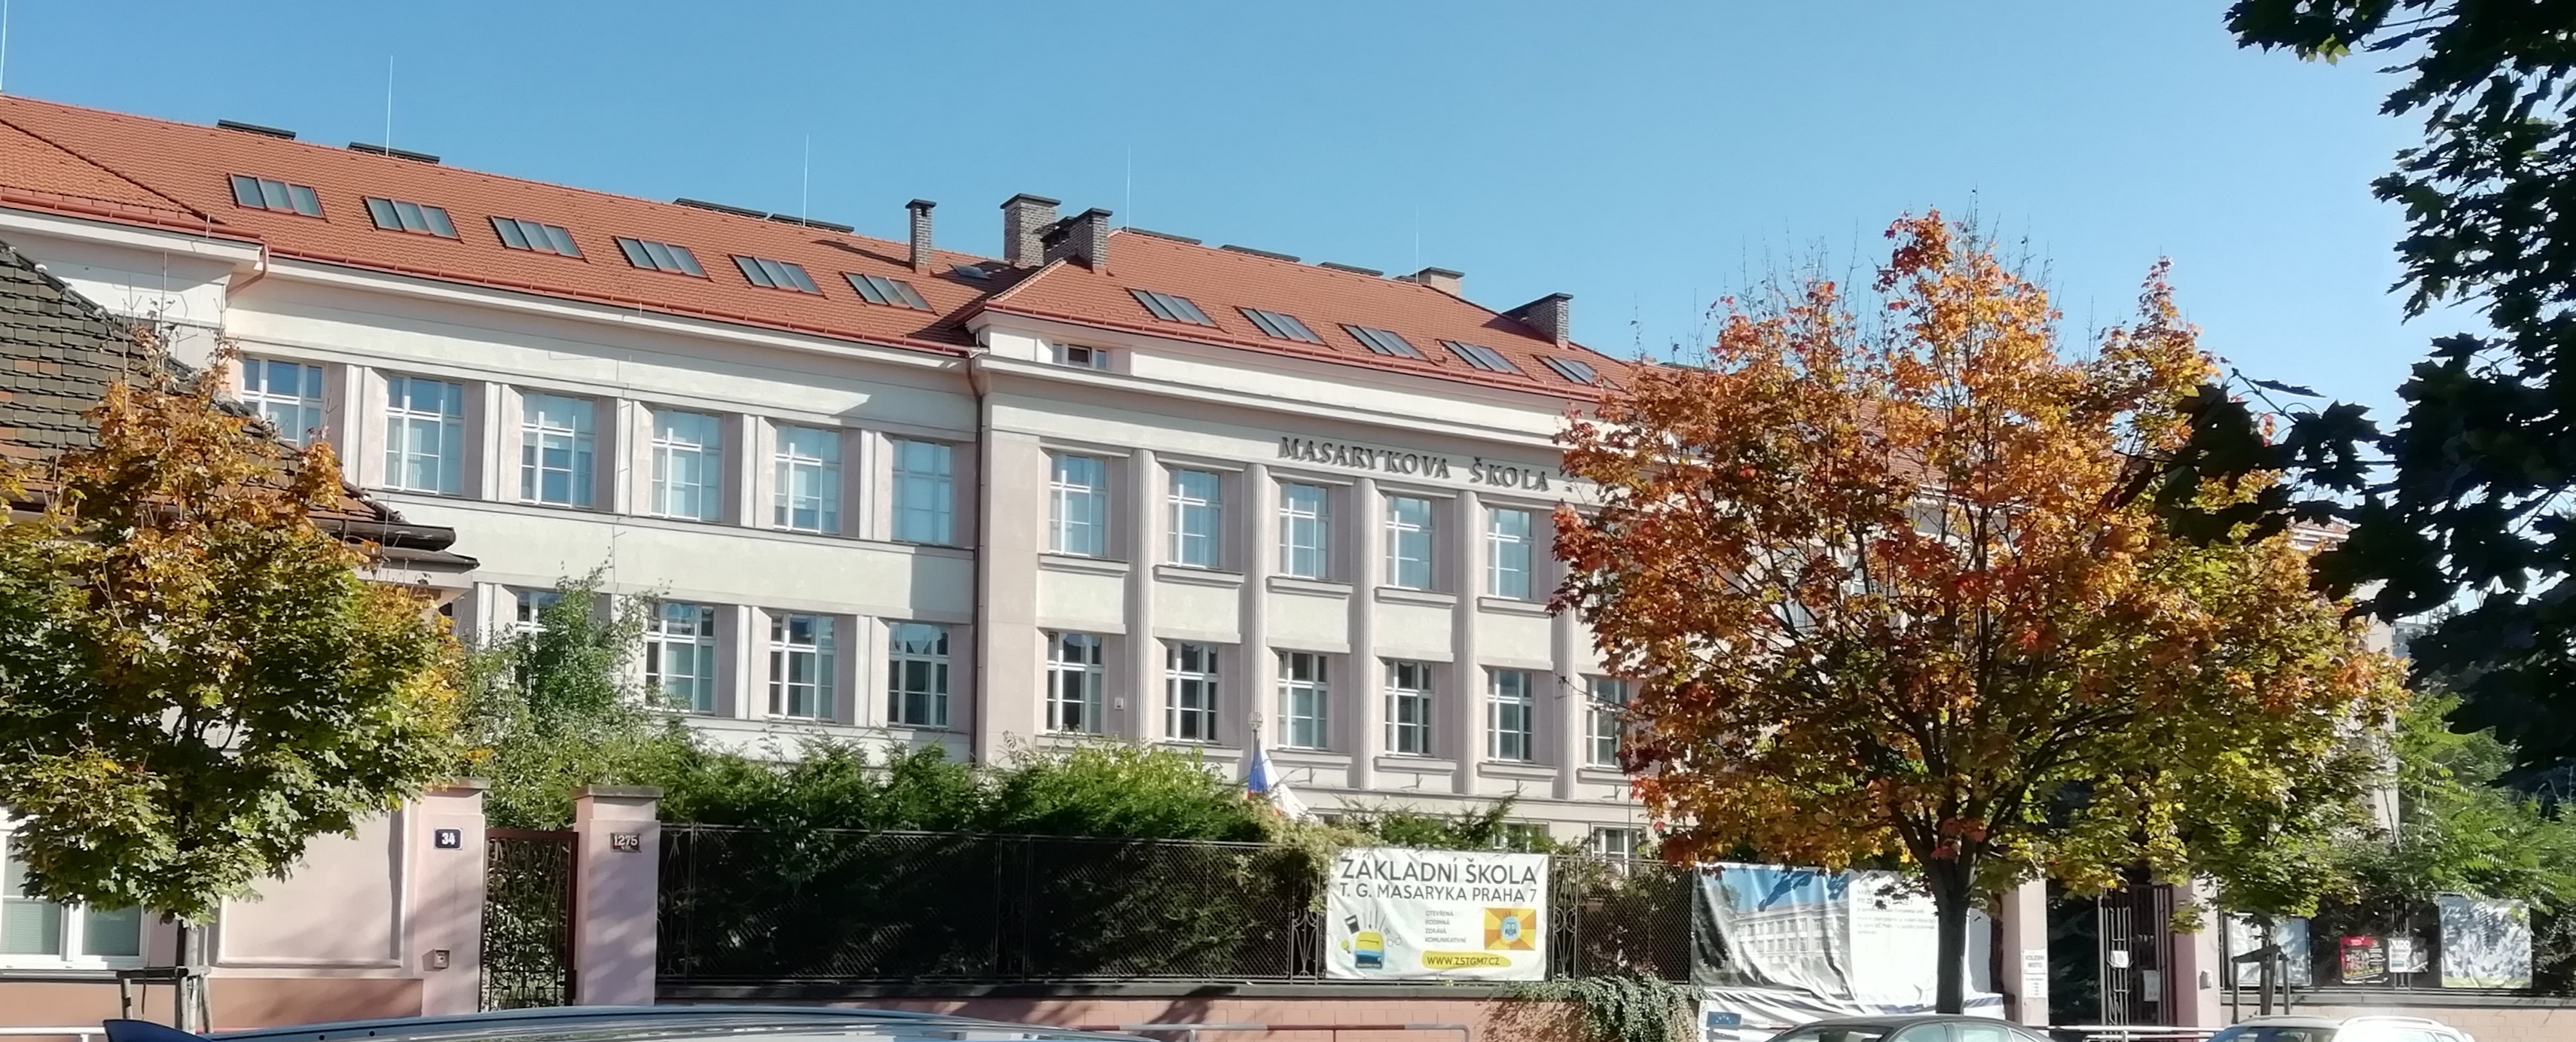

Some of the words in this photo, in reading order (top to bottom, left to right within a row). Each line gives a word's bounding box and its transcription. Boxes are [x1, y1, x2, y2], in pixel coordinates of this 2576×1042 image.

[1277, 437, 1451, 479] MASARYKOVA
[1470, 456, 1549, 491] ŠKOLA
[441, 832, 456, 845] 34
[614, 834, 638, 846] 1275
[1340, 854, 1458, 883] ZÁKLADNÍ
[1465, 858, 1537, 885] ŠKOLA
[1340, 882, 1351, 897] T.
[1356, 883, 1372, 897] G.
[1378, 884, 1467, 900] MASARYKA
[1473, 887, 1525, 902] PRAHA
[1530, 888, 1537, 902] 7
[1427, 956, 1500, 966] WWW.ZSTGM7.CZ
